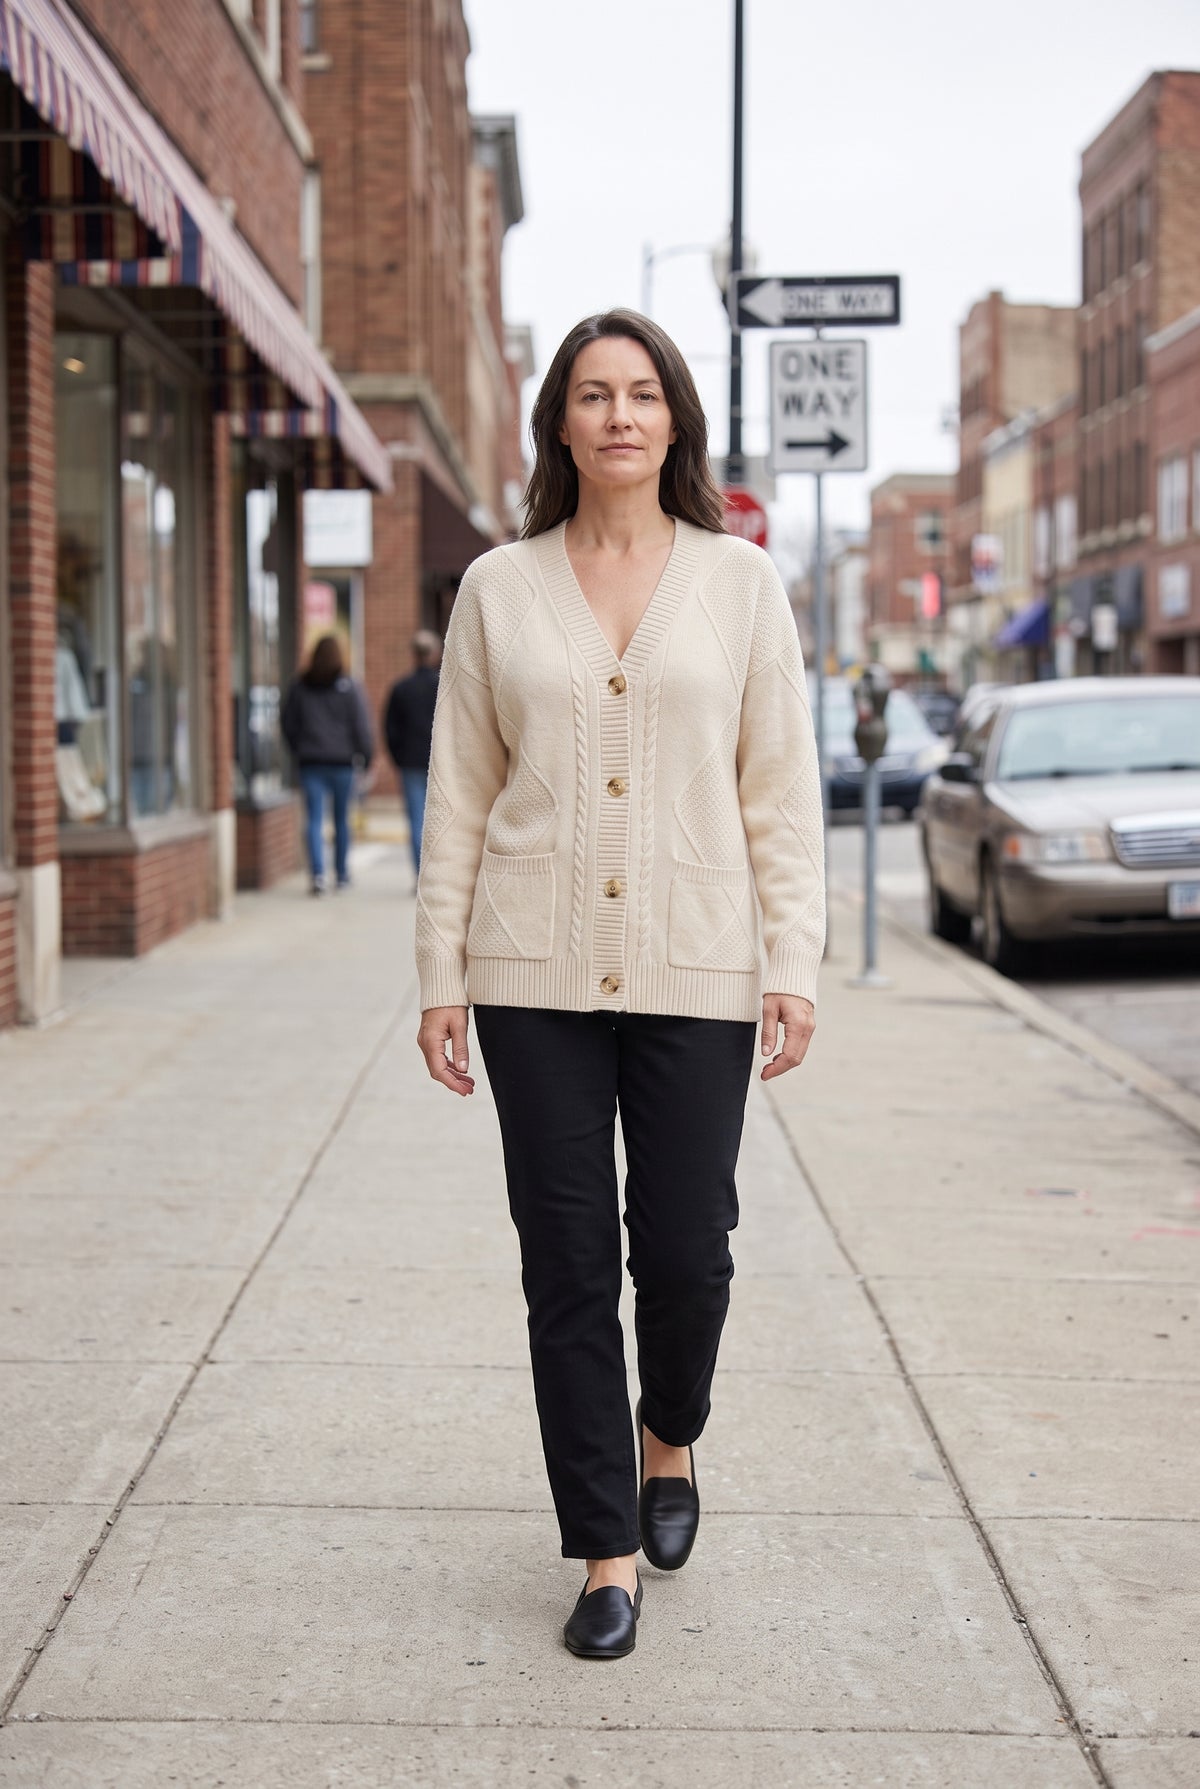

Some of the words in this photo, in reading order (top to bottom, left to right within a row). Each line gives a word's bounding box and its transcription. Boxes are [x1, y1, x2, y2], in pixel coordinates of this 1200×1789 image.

[785, 289, 826, 314] ONE
[836, 287, 884, 313] WAY
[780, 349, 855, 381] ONE
[778, 390, 857, 420] WAY
